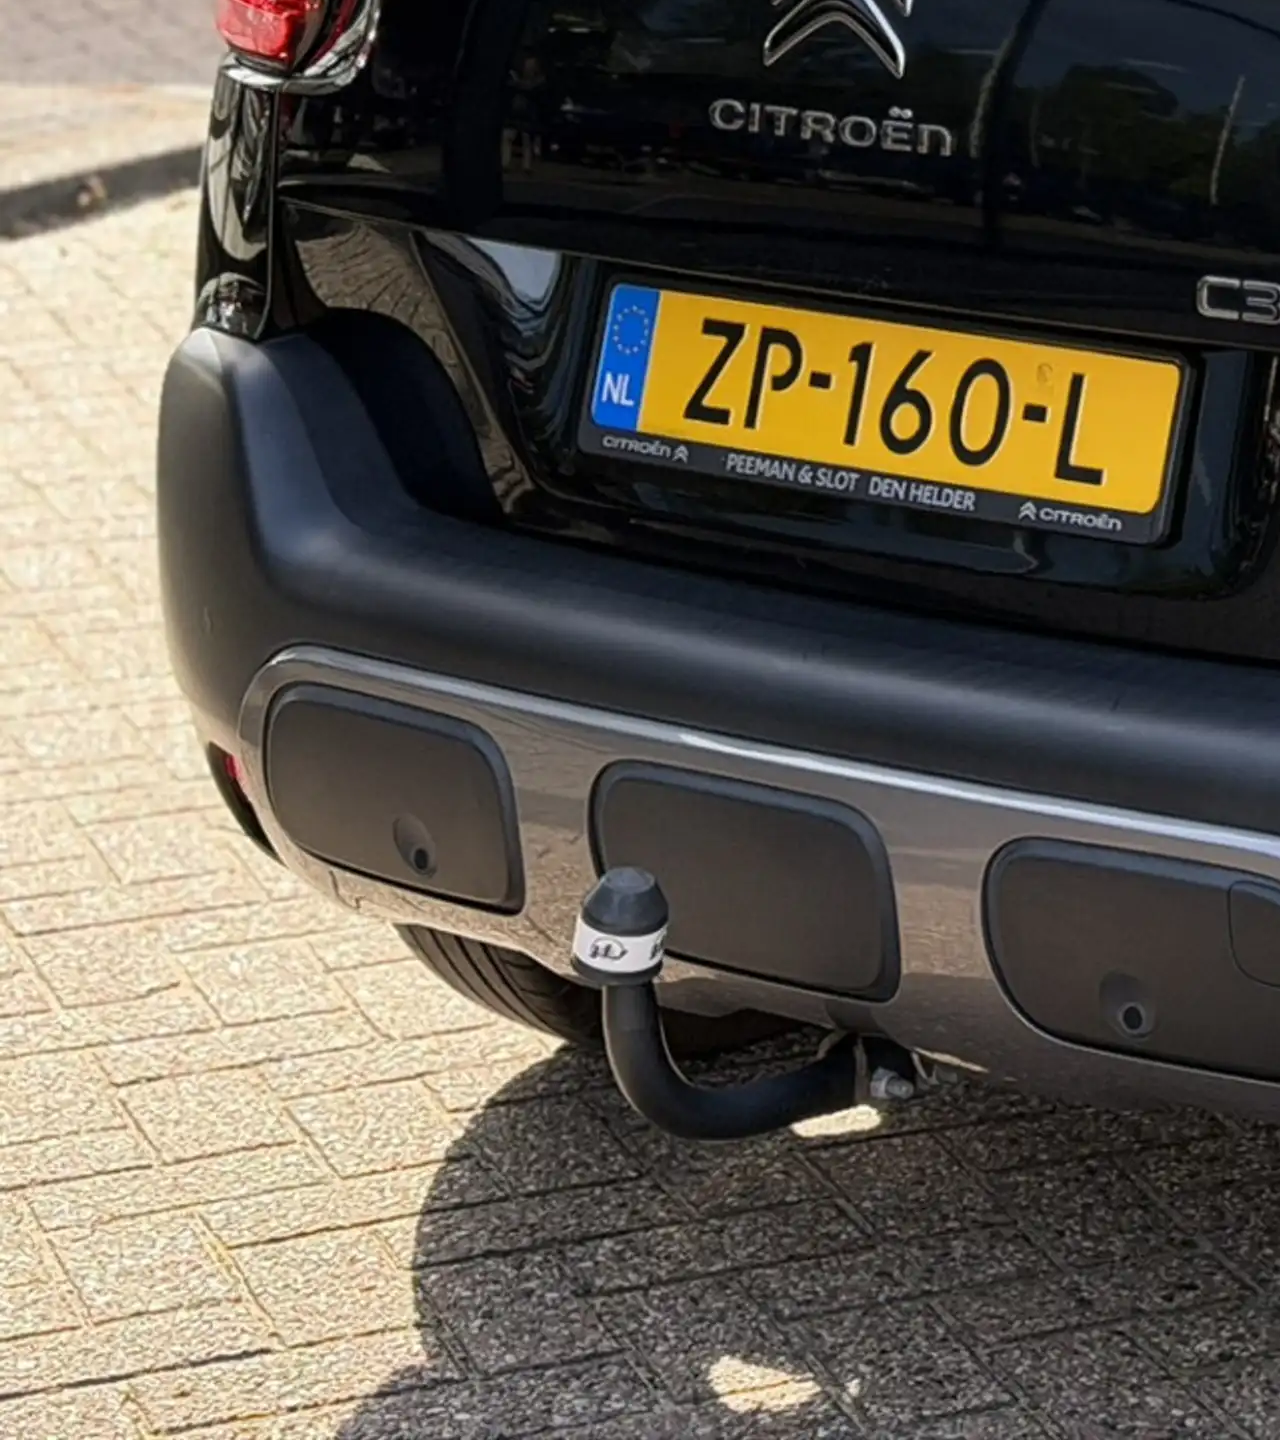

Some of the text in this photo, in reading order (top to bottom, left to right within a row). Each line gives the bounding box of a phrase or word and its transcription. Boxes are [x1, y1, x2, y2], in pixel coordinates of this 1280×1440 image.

[600, 371, 635, 408] NL
[683, 317, 1106, 486] ZP-160-L
[725, 452, 976, 512] PEEMAN & SLOT DEN HELDER
